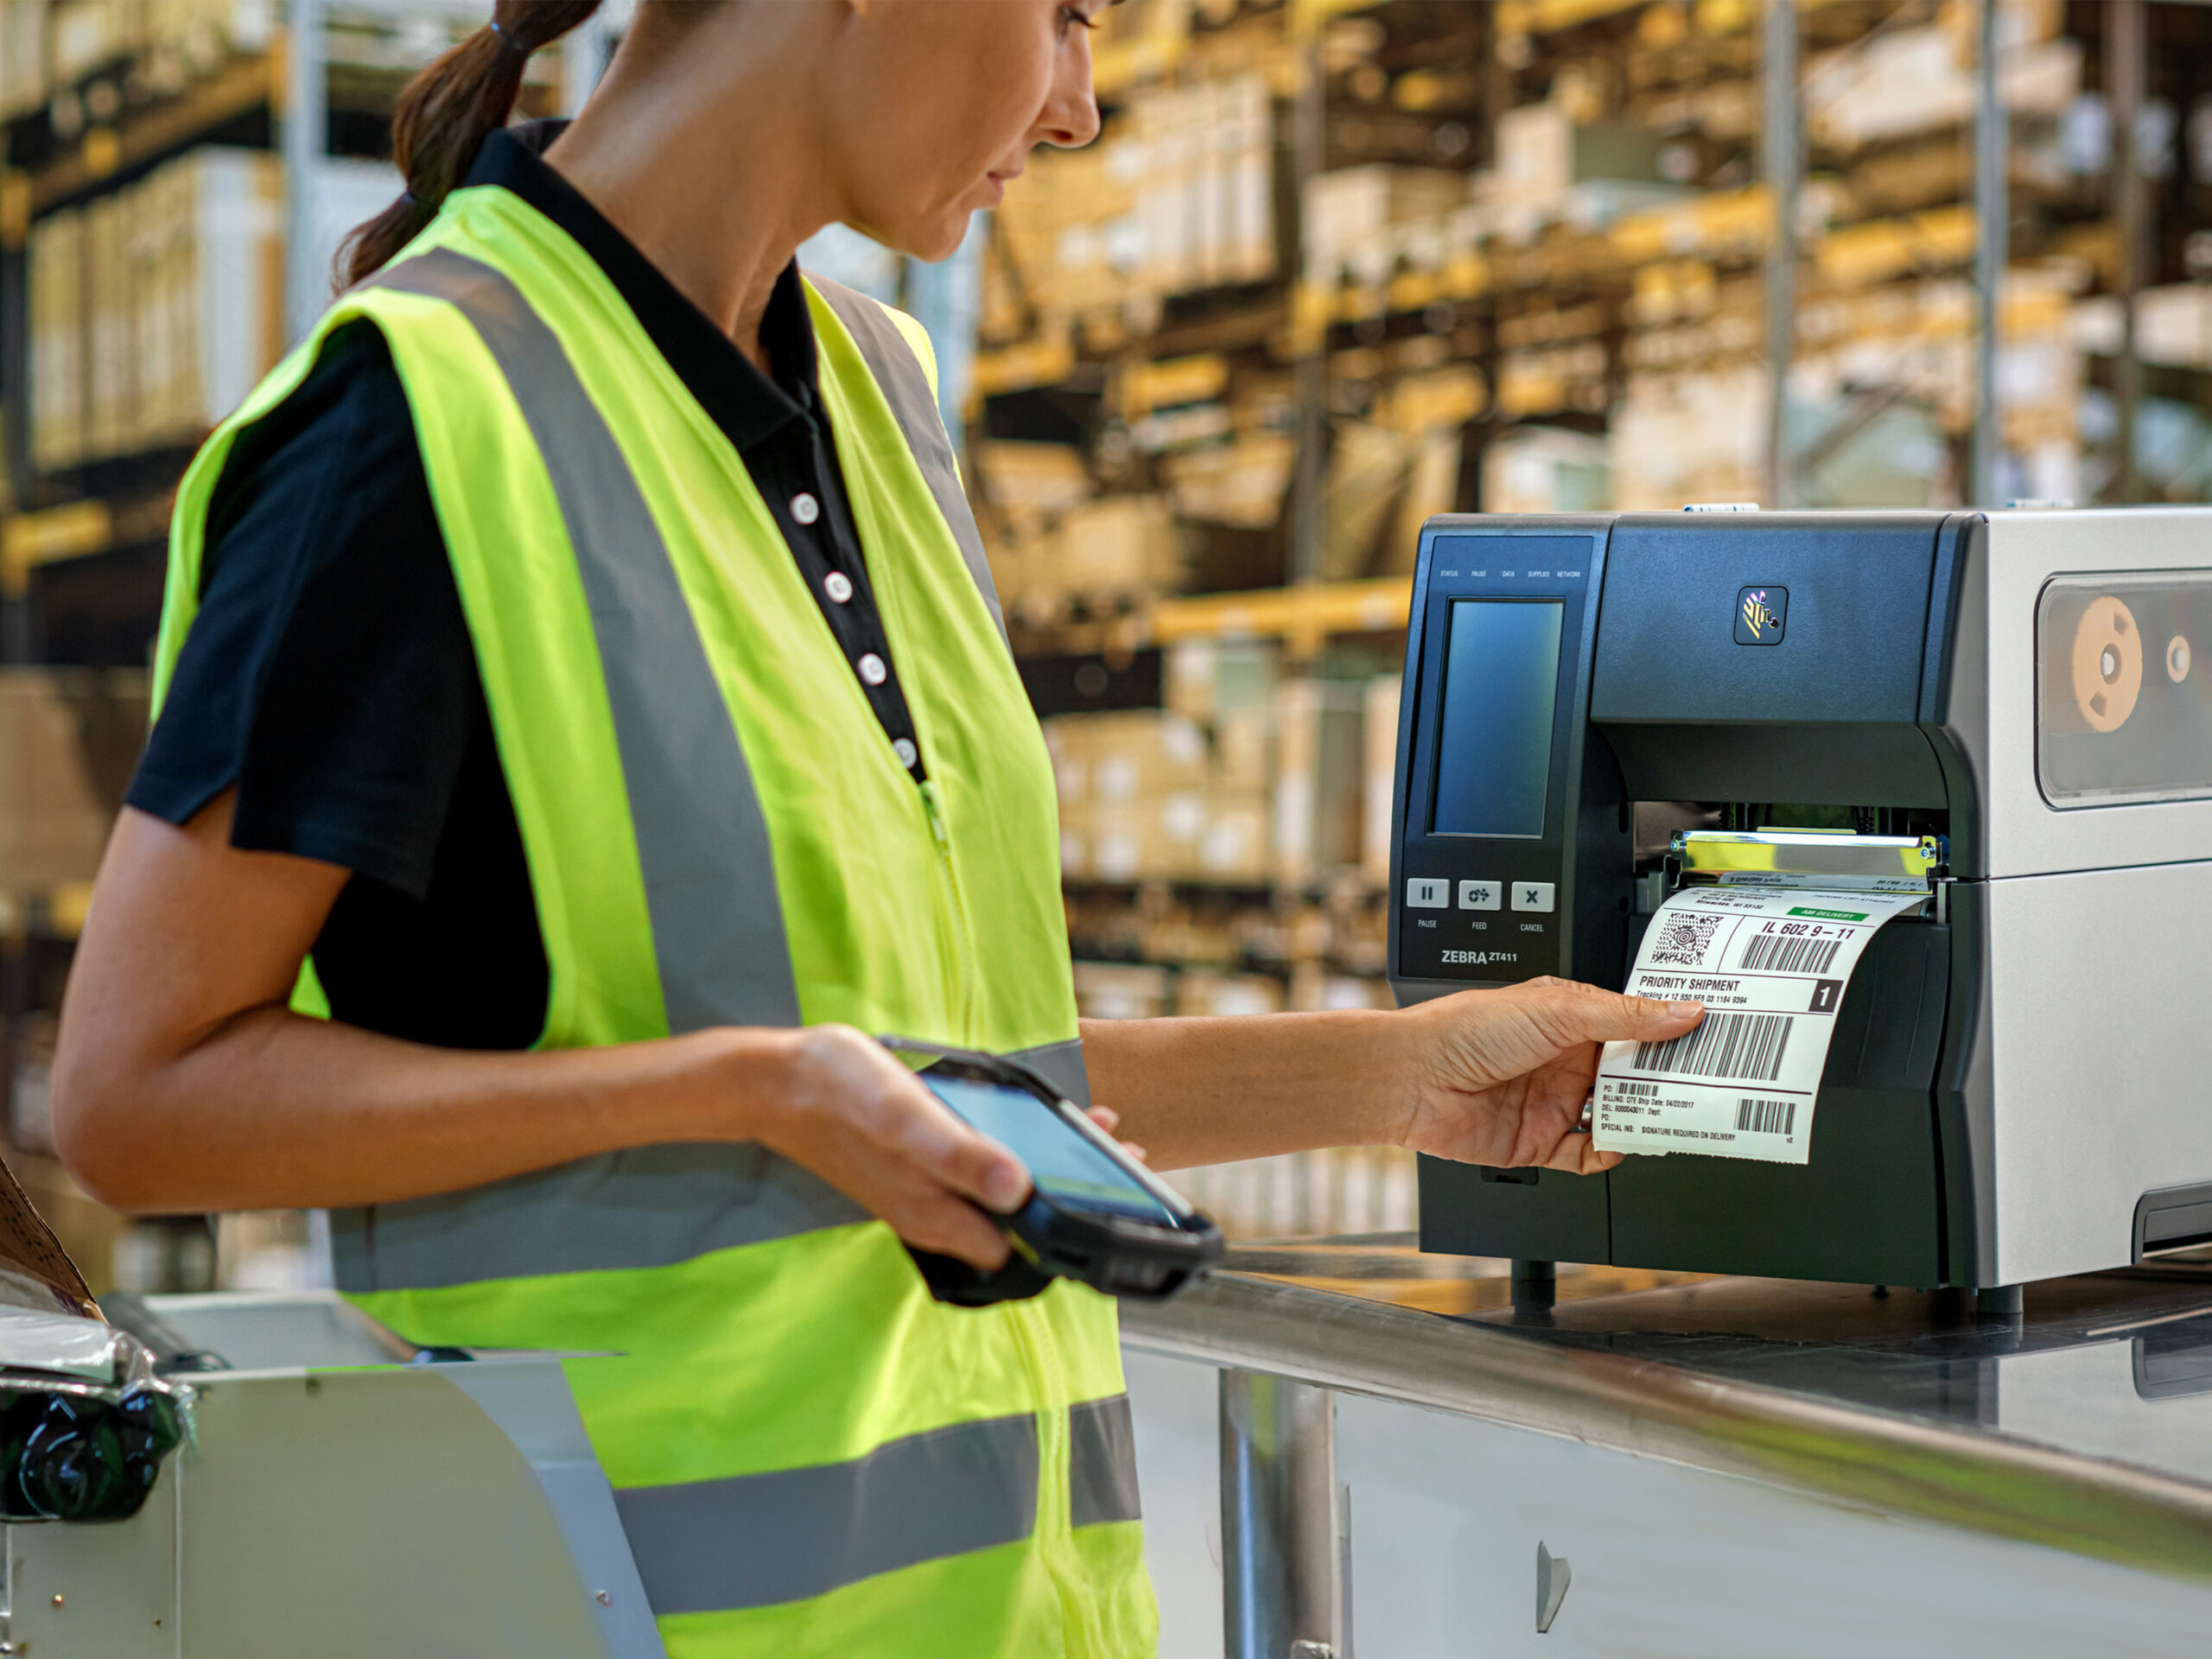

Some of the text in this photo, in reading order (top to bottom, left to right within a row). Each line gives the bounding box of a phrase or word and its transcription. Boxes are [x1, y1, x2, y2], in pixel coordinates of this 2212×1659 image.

[1815, 911, 1856, 919] DELIVERY
[1418, 919, 1437, 928] PAUSE
[1520, 924, 1544, 932] CANCEL
[1761, 921, 1777, 933] IL
[1780, 923, 1809, 936] 602
[1810, 925, 1823, 937] 9
[1837, 928, 1856, 940] 11
[1441, 950, 1517, 965] ZEBRA ZT411
[1639, 976, 1741, 992] PRIORITY SHIPMENT
[1637, 990, 1663, 1001] Tracking
[1820, 986, 1831, 1007] 1
[1602, 1103, 1613, 1112] DEL:
[1603, 1094, 1624, 1103] BILLING:
[1637, 1097, 1649, 1106] Ship
[1651, 1098, 1664, 1107] Date:
[1666, 1099, 1694, 1109] 04/22/2017
[1601, 1122, 1623, 1132] SPECIAL
[1642, 1126, 1671, 1136] SIGNATURE
[1672, 1128, 1700, 1139] REQUIRED
[1710, 1132, 1735, 1141] DELIVERY
